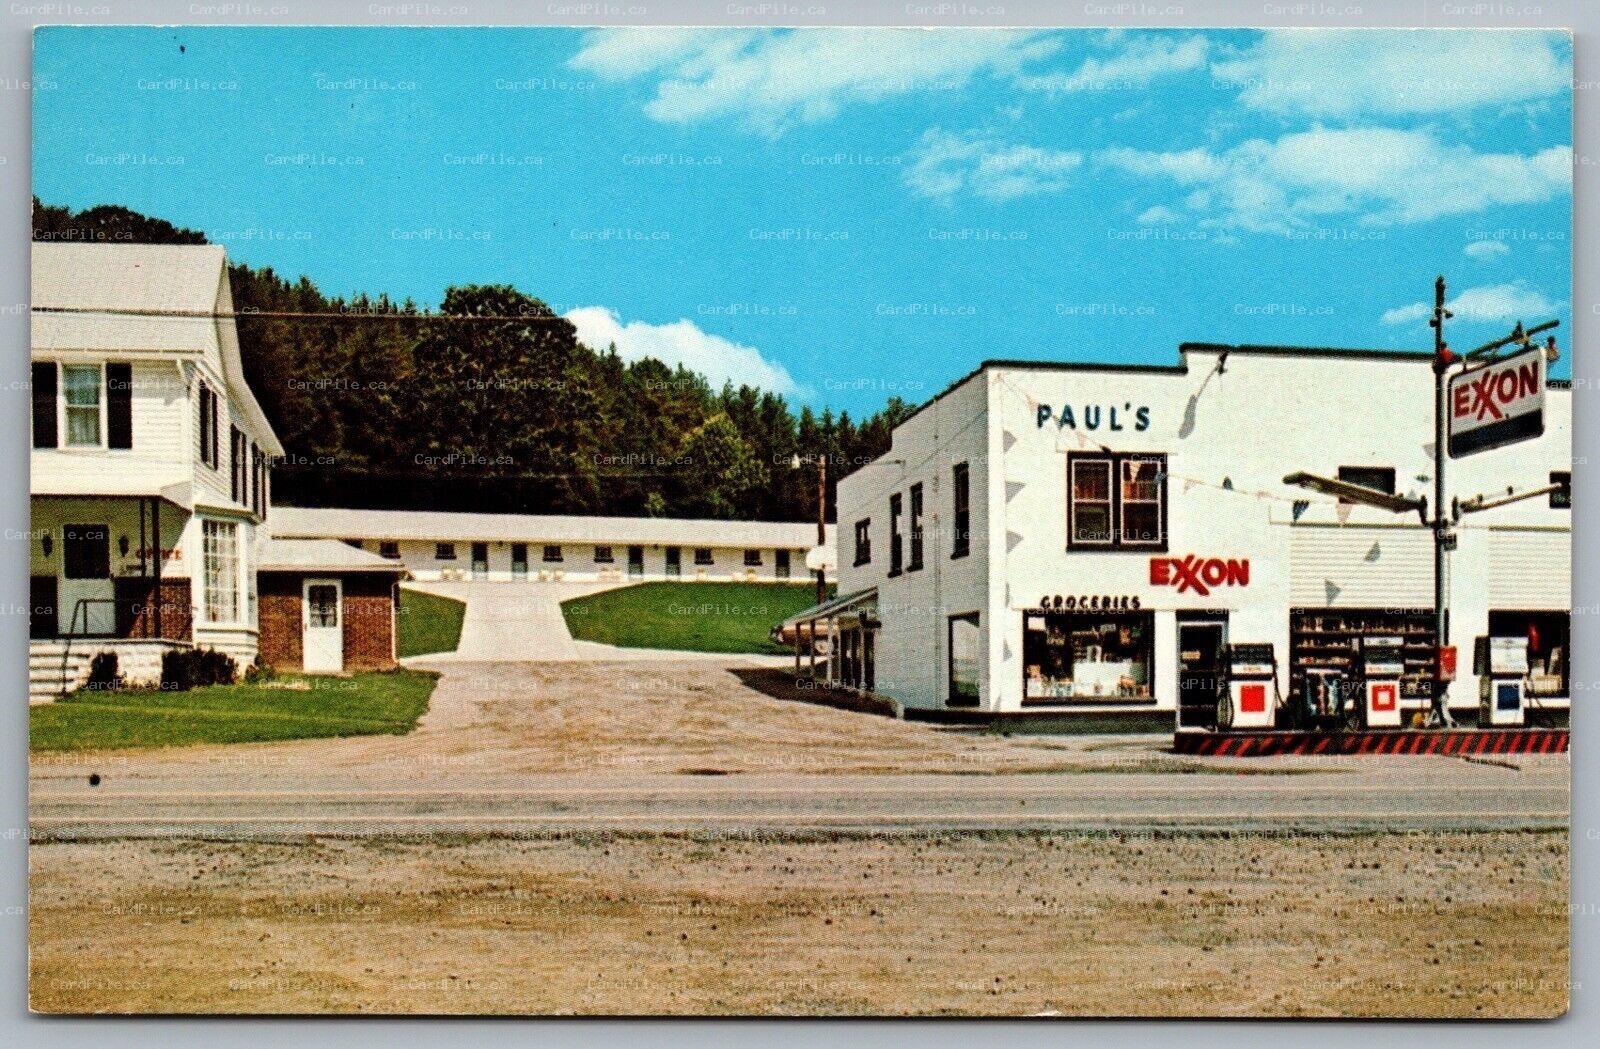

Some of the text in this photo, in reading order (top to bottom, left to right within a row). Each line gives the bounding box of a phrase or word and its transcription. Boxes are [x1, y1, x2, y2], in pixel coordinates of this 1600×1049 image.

[1454, 361, 1539, 421] EXXON
[1037, 402, 1150, 431] PAUL'S
[1150, 554, 1249, 595] EXXON
[1040, 595, 1141, 609] GROCERIES
